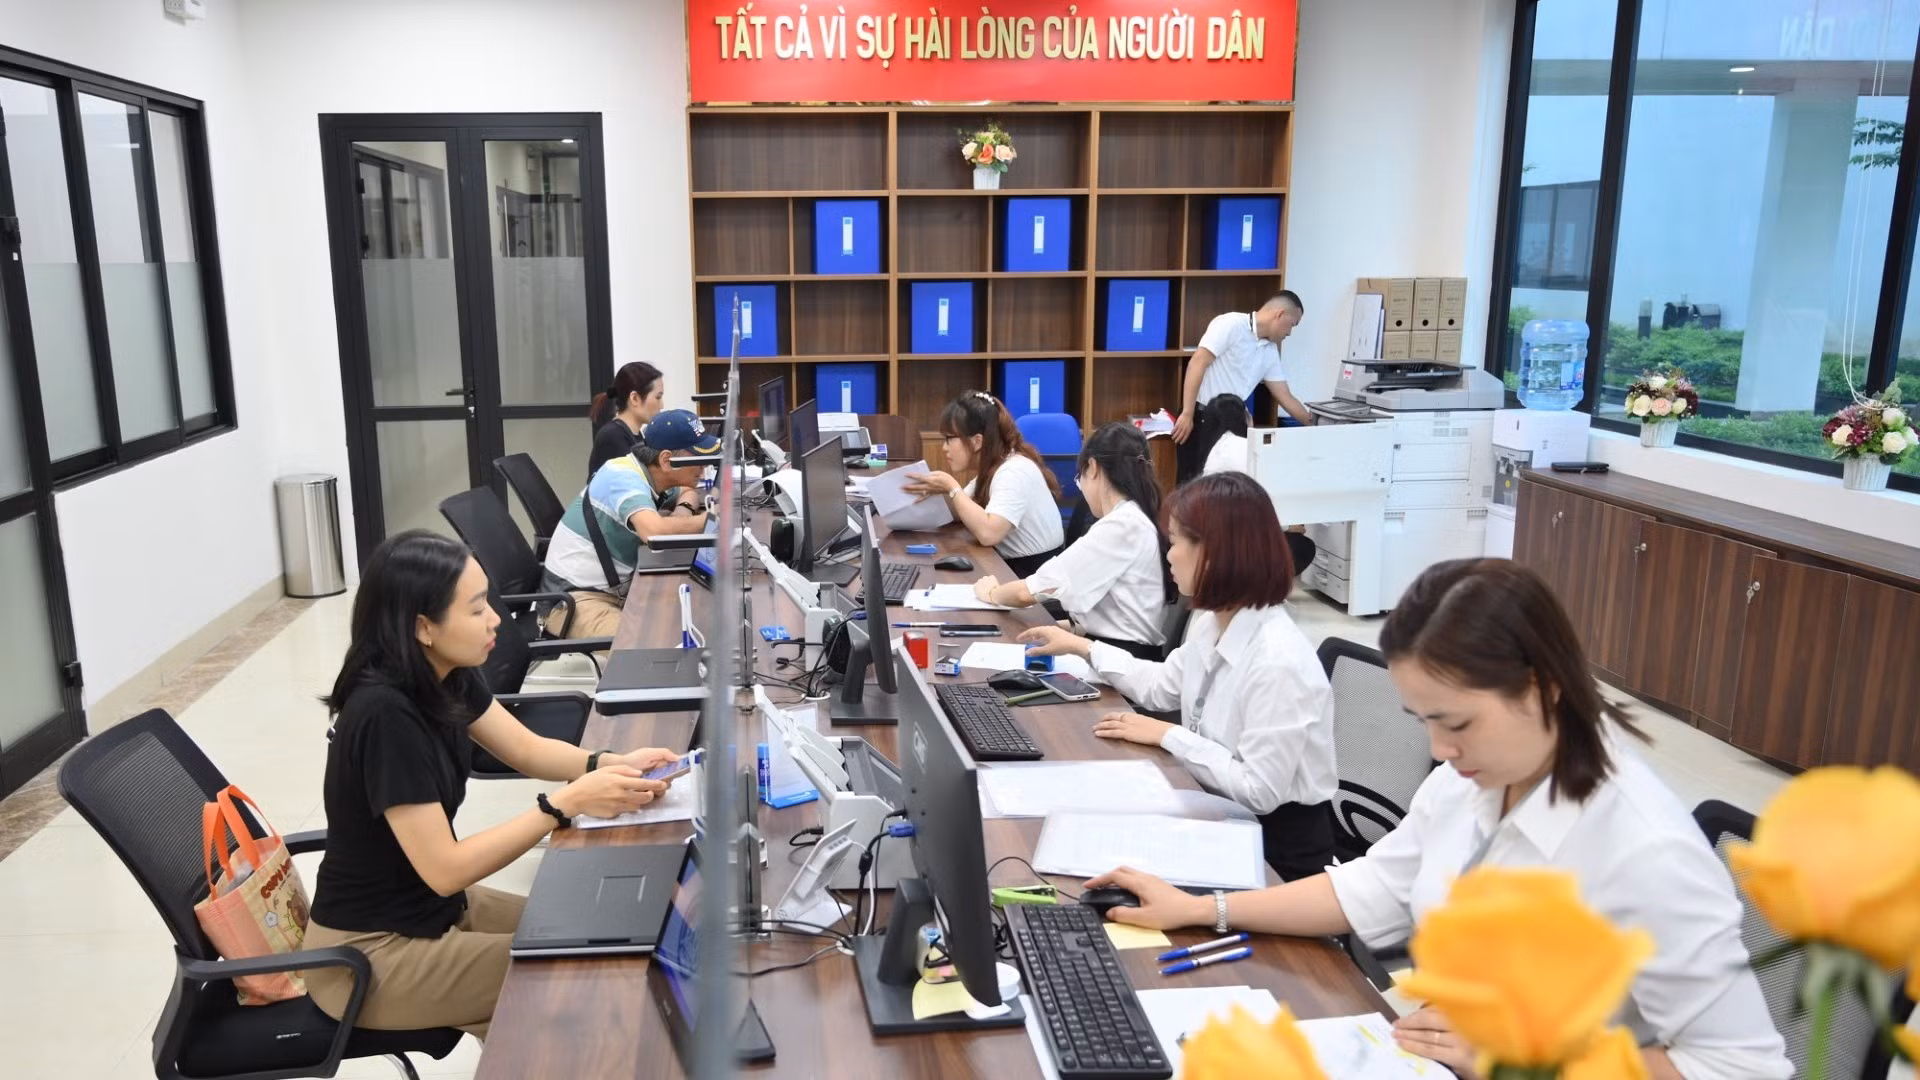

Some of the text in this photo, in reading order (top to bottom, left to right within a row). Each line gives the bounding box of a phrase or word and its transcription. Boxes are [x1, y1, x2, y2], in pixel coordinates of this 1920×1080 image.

[715, 3, 1265, 68] TẤT CẢ VÌ SỰ HÀI LÒNG CỦA NGƯỜI DÂN
